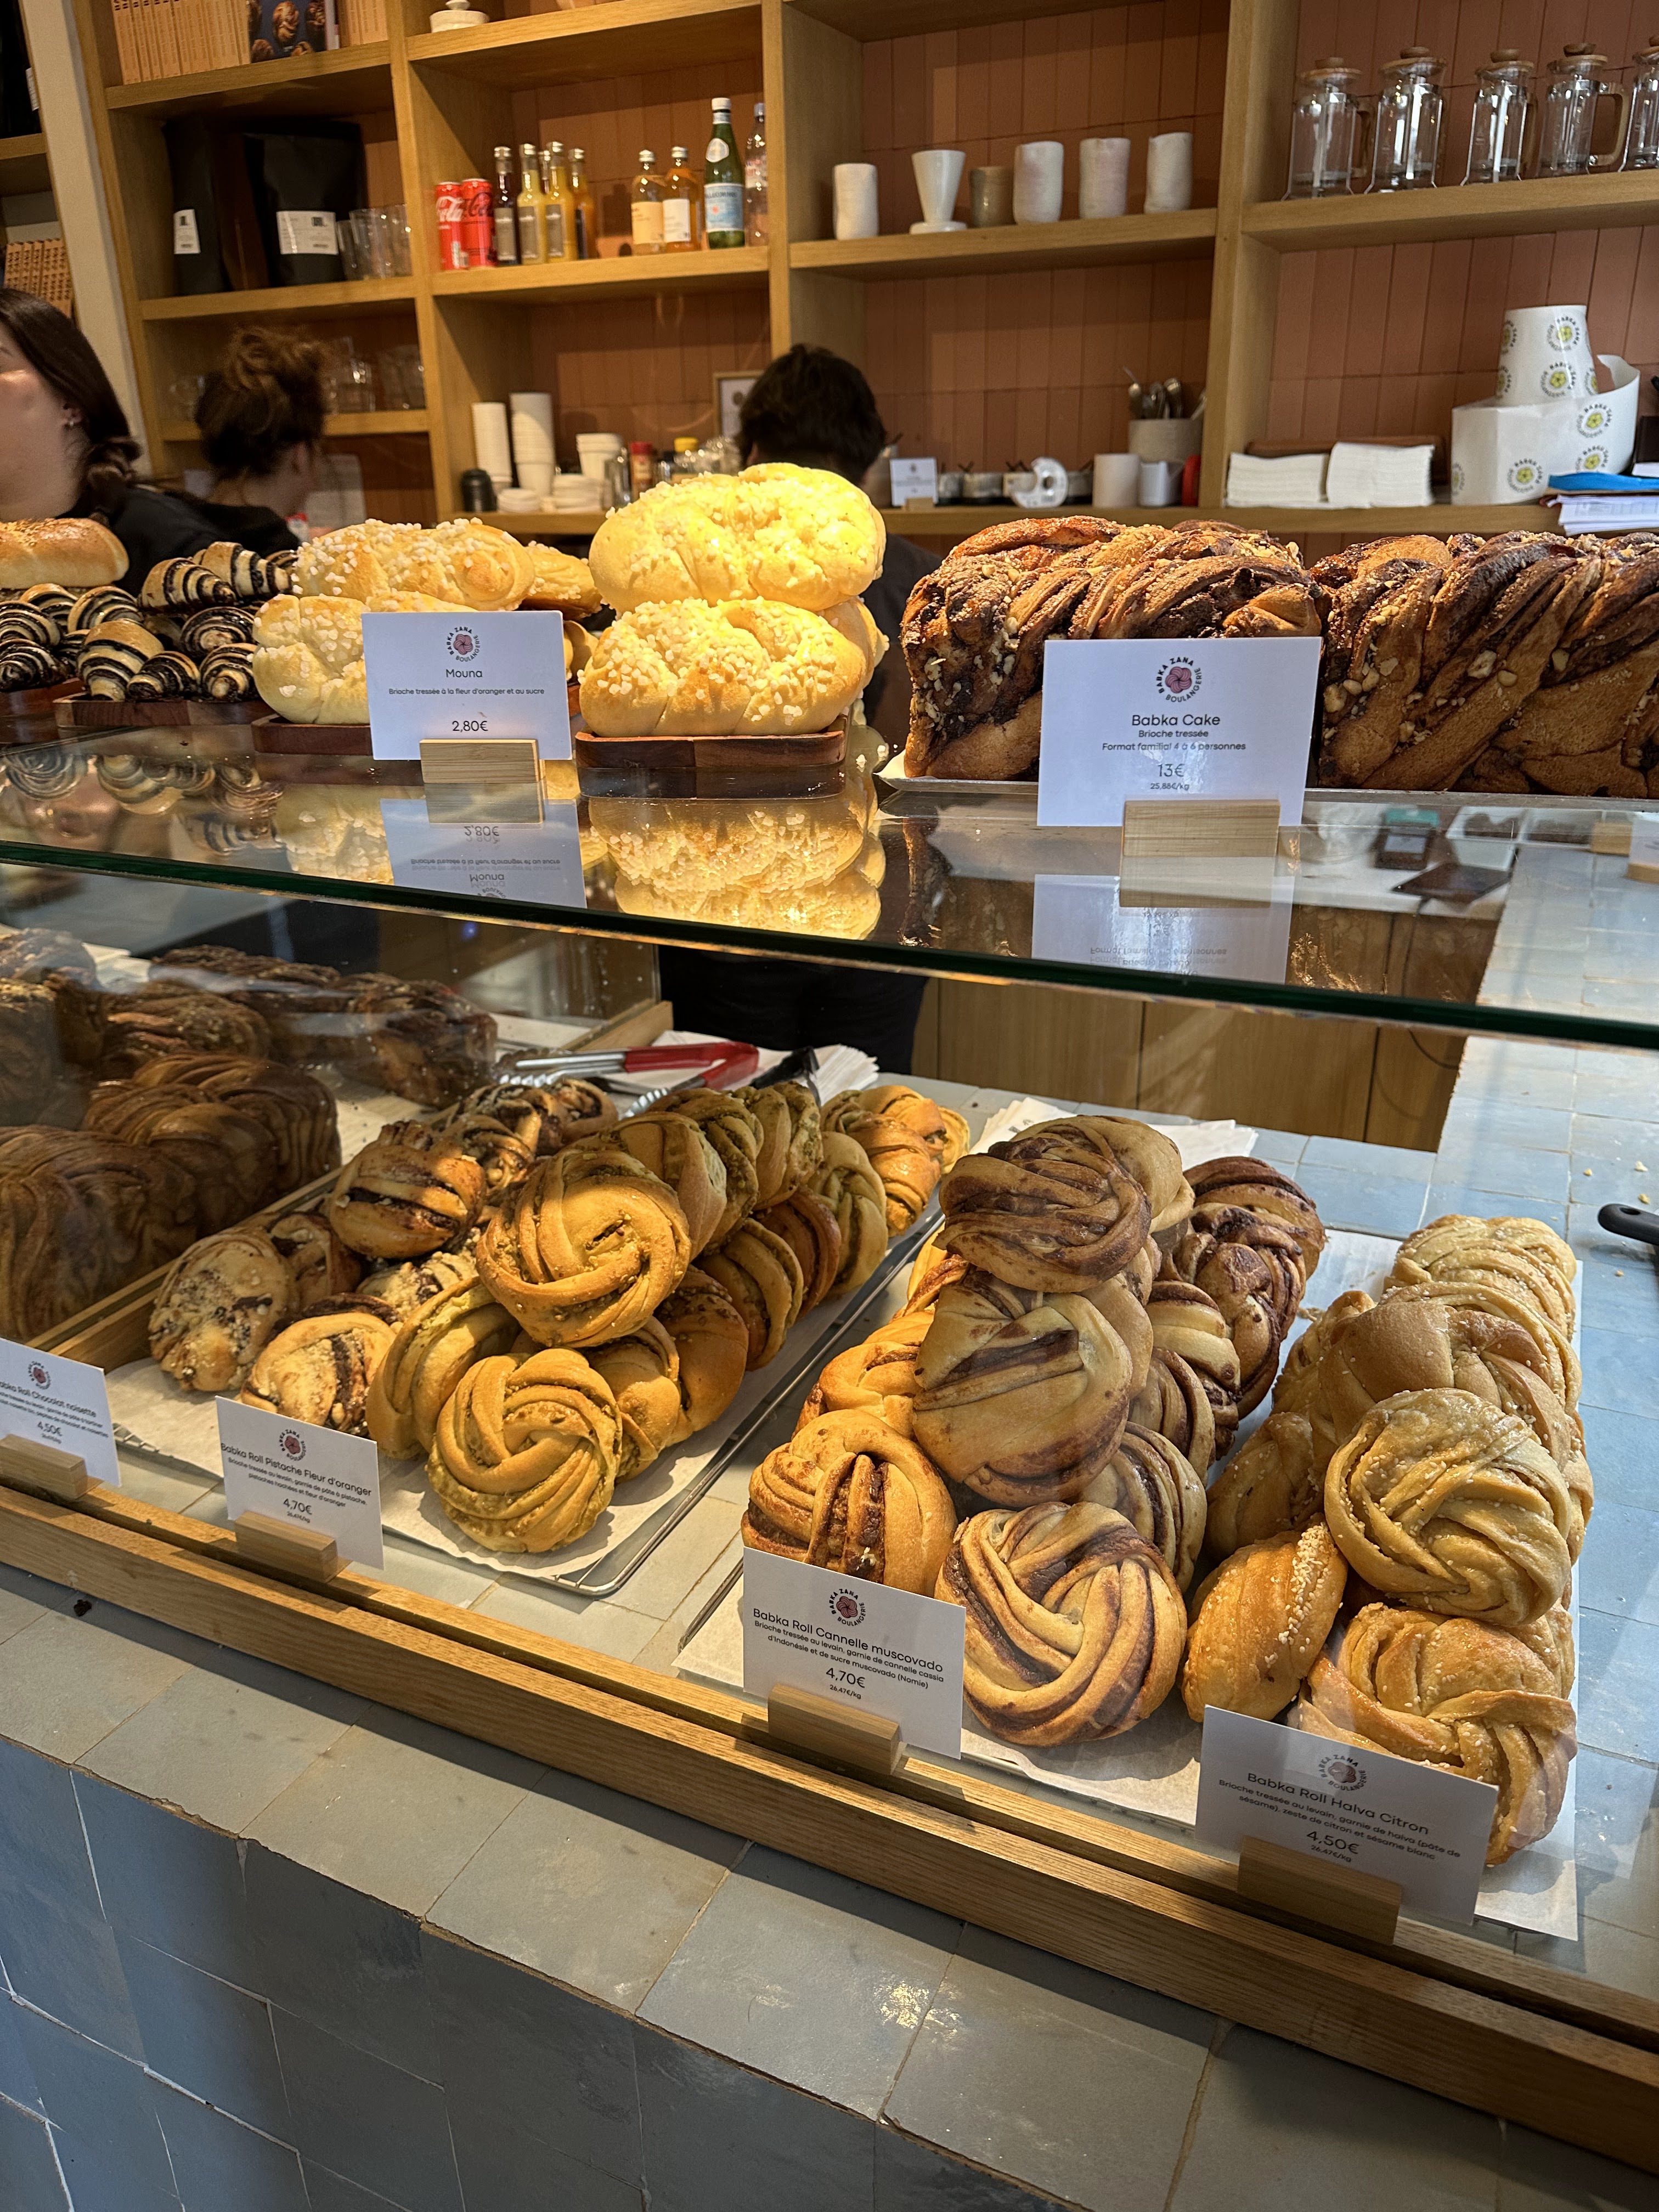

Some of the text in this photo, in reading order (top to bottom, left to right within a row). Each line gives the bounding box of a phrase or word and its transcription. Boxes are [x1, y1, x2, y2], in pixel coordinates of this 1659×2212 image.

[456, 635, 480, 662] BOULANGERIE
[446, 669, 483, 678] Mouna
[1156, 657, 1194, 693] BABKA ZANA
[1166, 668, 1202, 702] BOULANGERIE
[452, 720, 488, 732] 2,80€
[1132, 714, 1221, 726] Babka Cake
[1158, 764, 1184, 777] 13€
[1150, 782, 1189, 791] 25,88€/kg
[0, 1381, 16, 1392] abka
[221, 1442, 371, 1496] Babka Roll Pistache Fleur d'oranger
[283, 1498, 312, 1515] 4,70€
[829, 1588, 859, 1615] BABKA ZANA
[838, 1602, 866, 1627] BOULANGERIE
[753, 1608, 943, 1672] Babka Roll Cannelle muscovado
[755, 1620, 781, 1633] Brioche
[783, 1629, 809, 1642] tressée
[821, 1640, 845, 1654] levain,
[847, 1649, 871, 1661] garnie
[884, 1660, 917, 1674] cannelle
[918, 1671, 944, 1683] cassia
[768, 1635, 809, 1652] d'Indonésie
[830, 1654, 850, 1665] sucre
[852, 1661, 896, 1678] muscovado
[826, 1667, 866, 1688] 4,70€
[1318, 1754, 1358, 1778] BABKA ZANA
[1328, 1770, 1367, 1791] BOULANGERIE
[1248, 1773, 1429, 1835] Babka Roll Halva Citron
[1219, 1779, 1460, 1858] Brioche tressée au levain, garnie de halva (pâte de
[1283, 1808, 1307, 1820] zeste
[1310, 1816, 1322, 1824] de
[1324, 1821, 1352, 1834] citron
[1366, 1833, 1404, 1850] sésame
[1407, 1846, 1436, 1859] blanc
[1306, 1831, 1359, 1854] 4,50€
